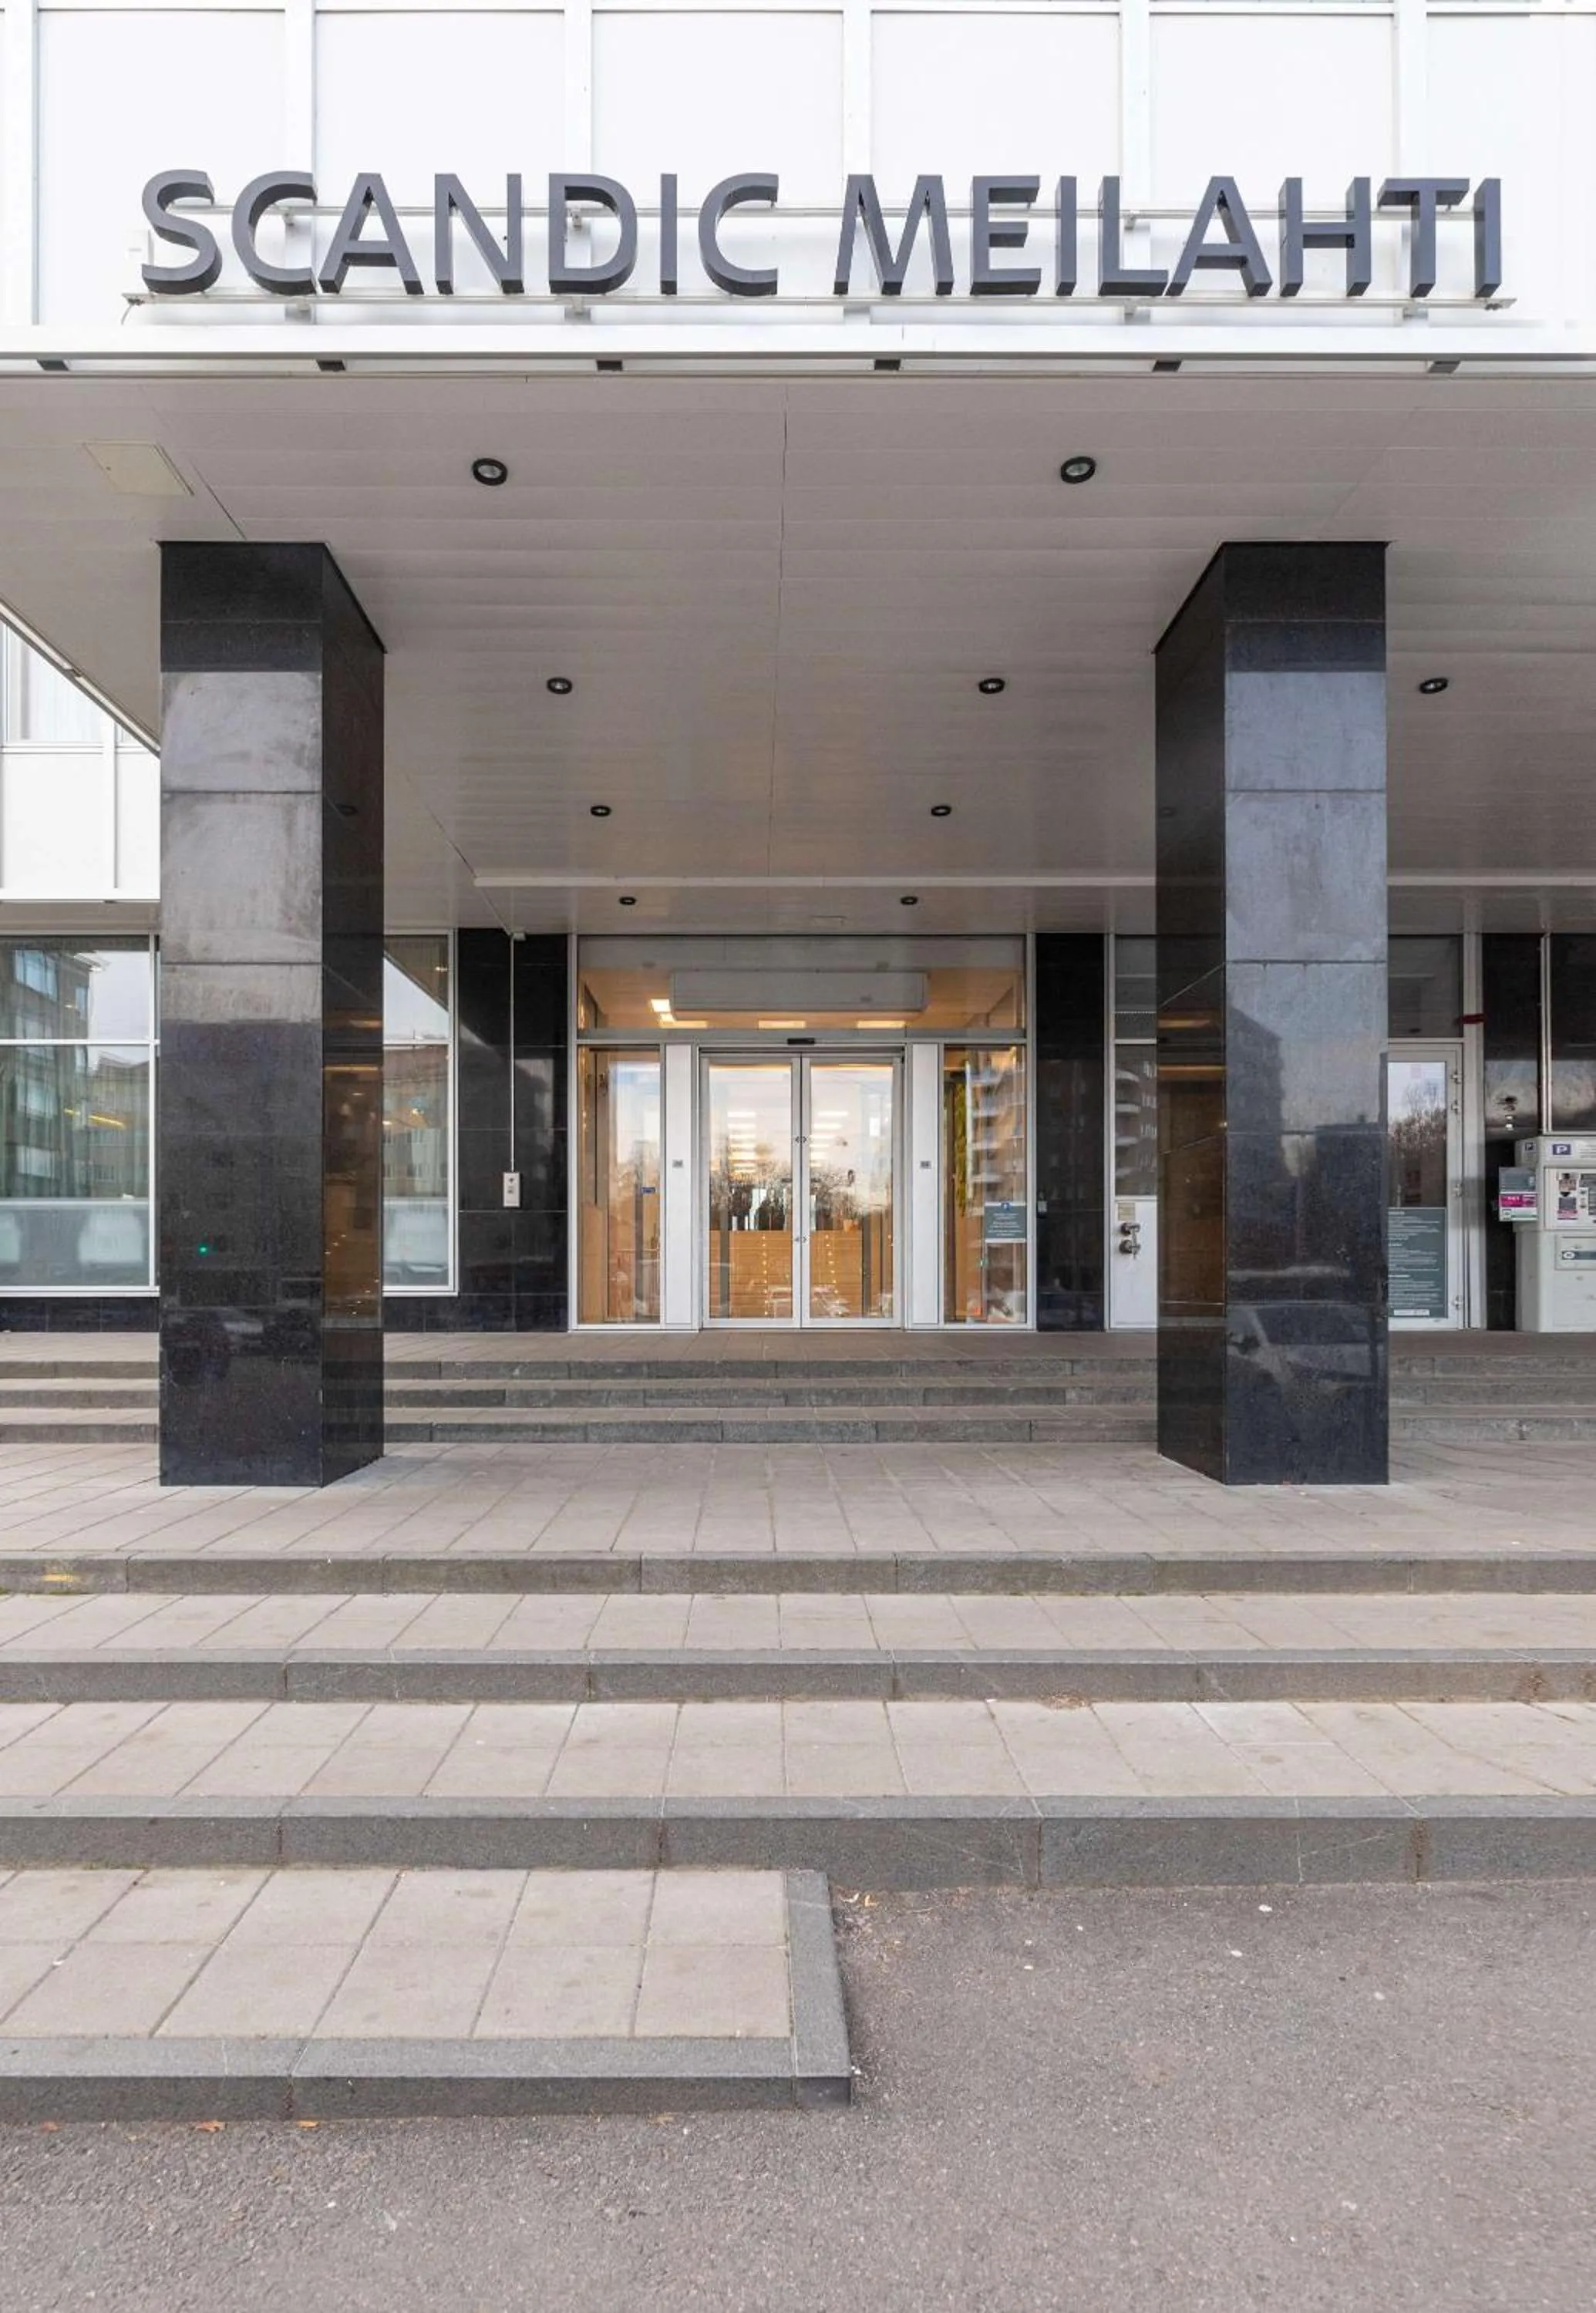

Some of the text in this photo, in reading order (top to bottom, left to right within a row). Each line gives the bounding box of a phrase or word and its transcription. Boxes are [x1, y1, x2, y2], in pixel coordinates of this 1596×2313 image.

[142, 169, 1502, 299] SCANDIC MEILAHTI
[1555, 1145, 1568, 1154] P
